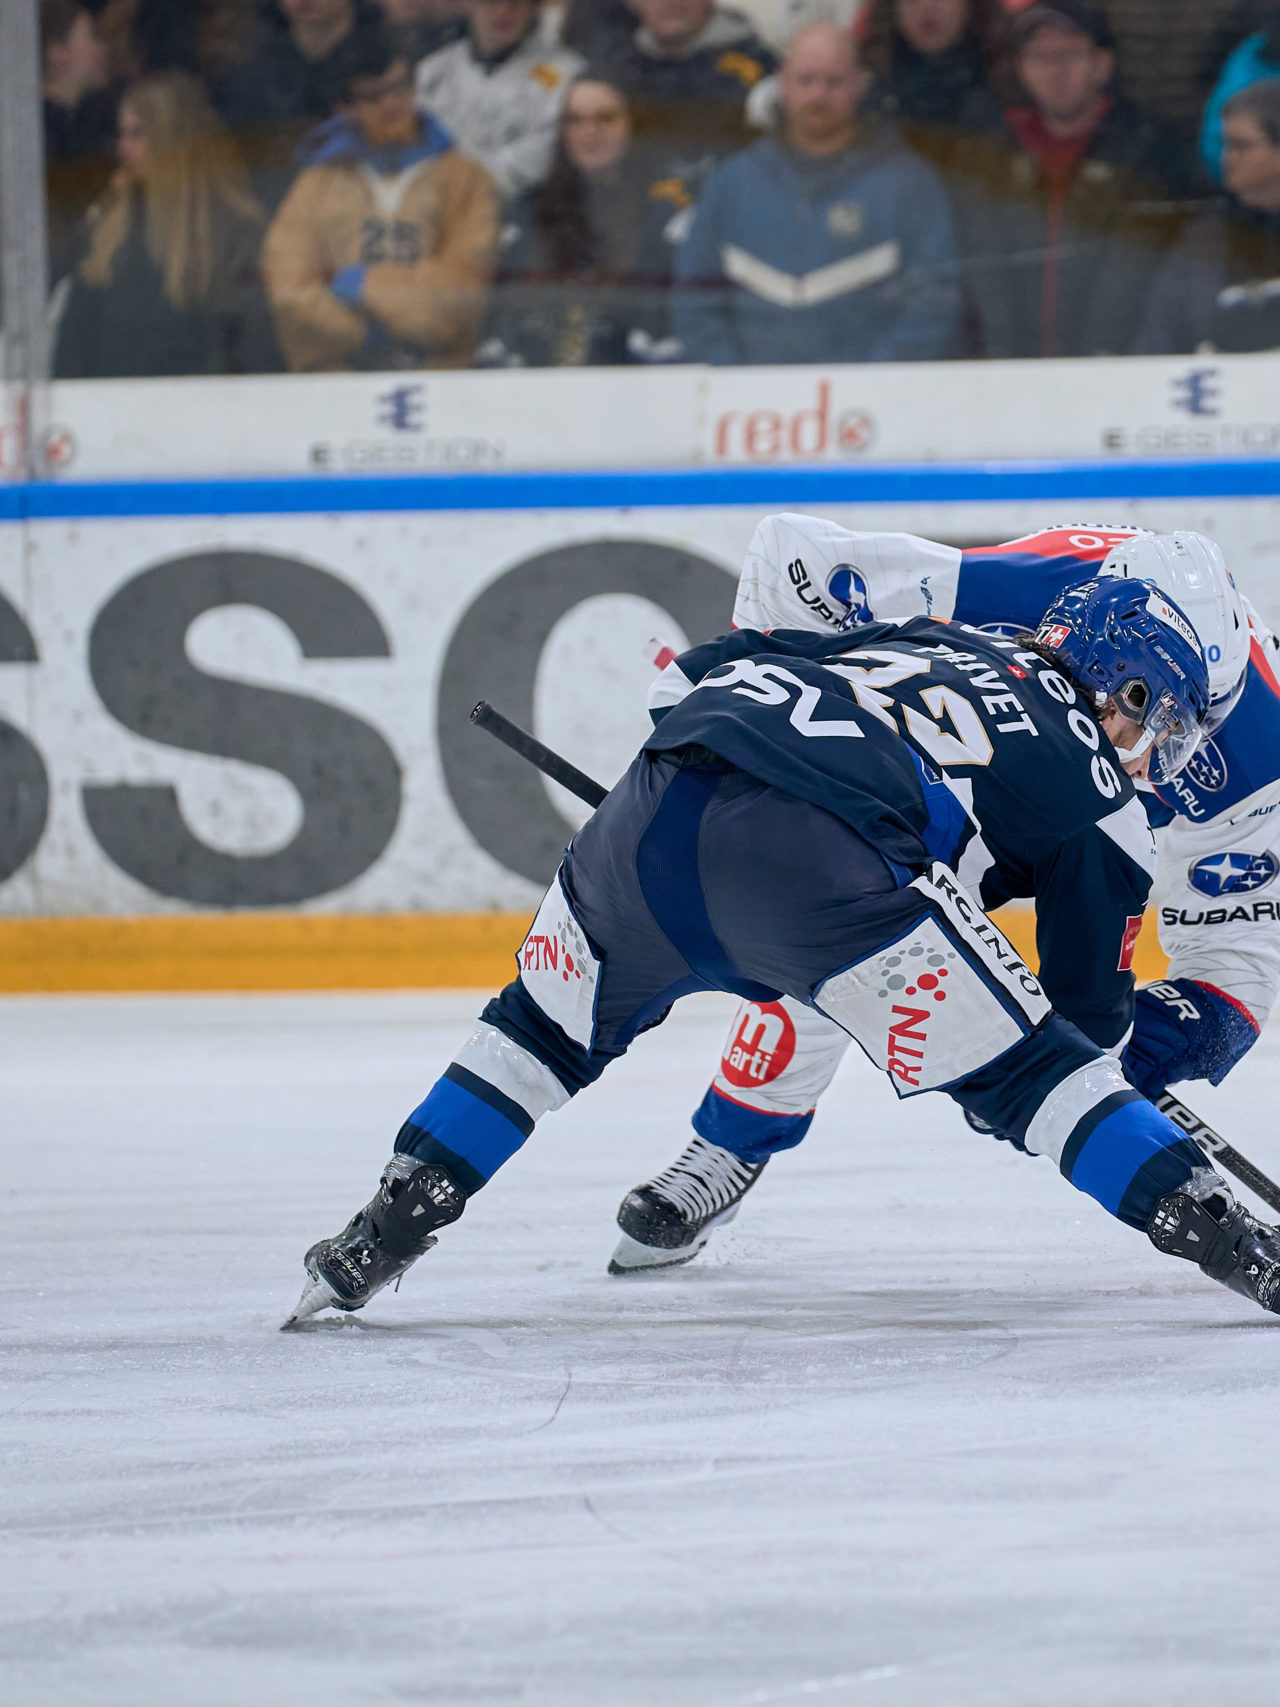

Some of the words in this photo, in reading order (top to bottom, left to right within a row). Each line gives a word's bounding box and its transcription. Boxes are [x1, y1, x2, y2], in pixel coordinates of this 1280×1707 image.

[715, 376, 829, 462] red
[912, 643, 1040, 737] PRIVET
[523, 935, 558, 971] RTN
[888, 1004, 931, 1087] RTN
